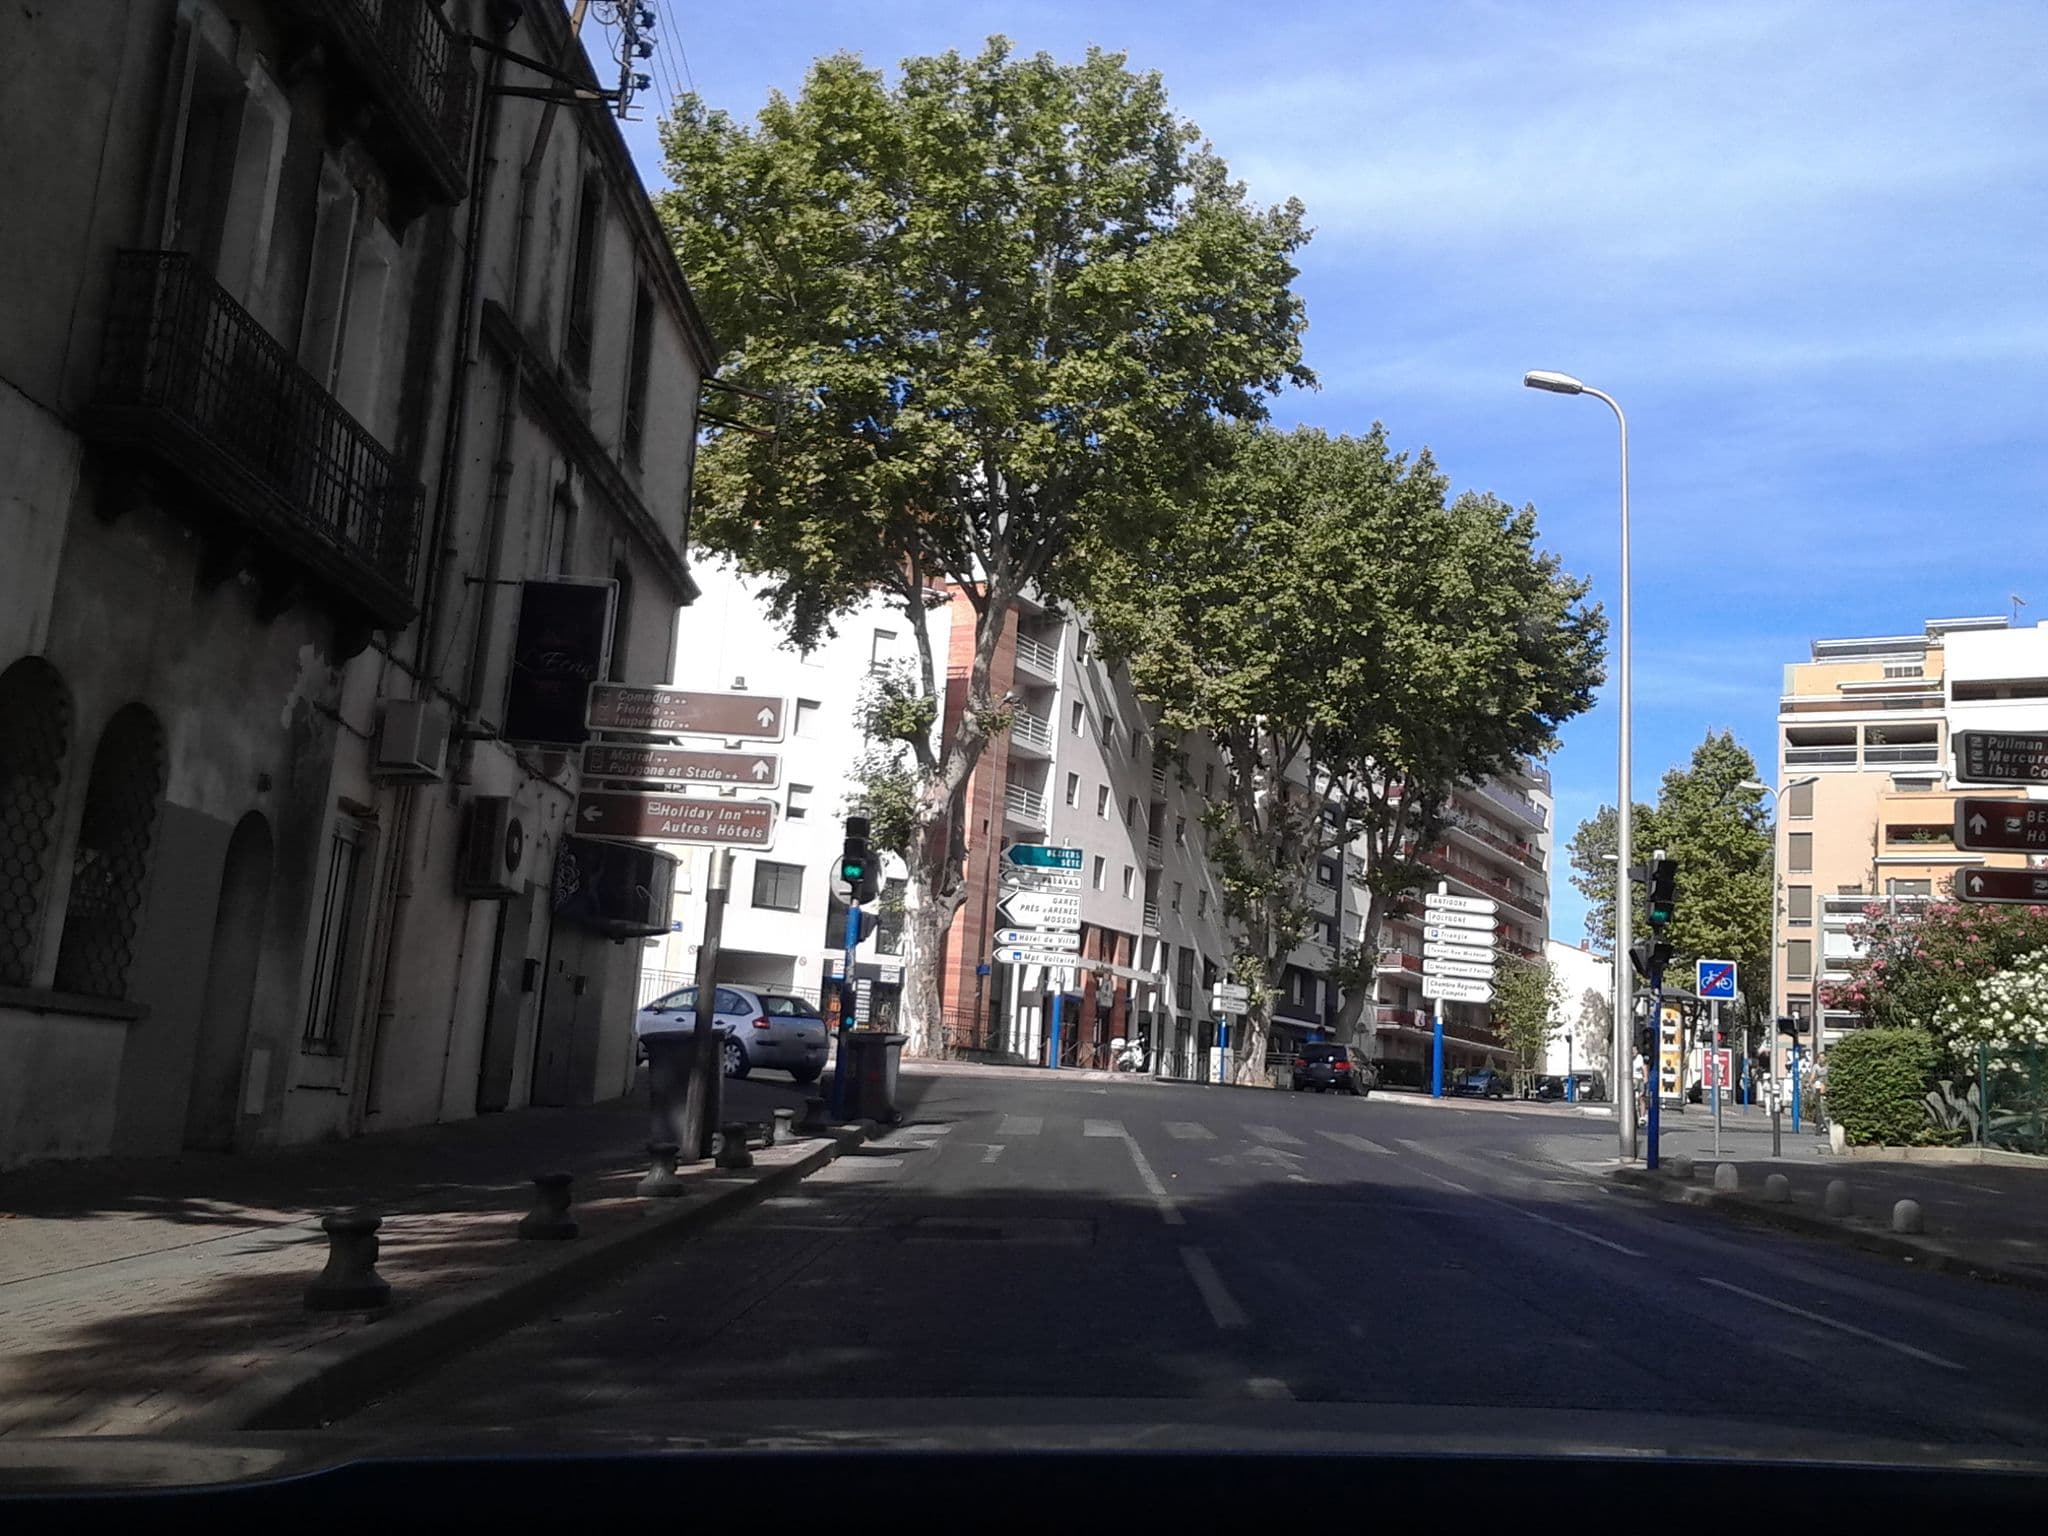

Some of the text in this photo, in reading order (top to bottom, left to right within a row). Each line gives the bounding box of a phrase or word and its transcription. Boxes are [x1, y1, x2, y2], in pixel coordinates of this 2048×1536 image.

[1987, 737, 2043, 750] Pullman
[610, 749, 654, 763] Mistral
[609, 762, 722, 780] Polygone et Stade
[1988, 763, 2018, 776] Ibis
[660, 804, 741, 821] Holiday Inn
[661, 821, 763, 838] Autres Hôtels
[1052, 897, 1078, 906] GARES
[1433, 898, 1467, 907] ANTIGONE
[1043, 915, 1077, 924] MOSSON
